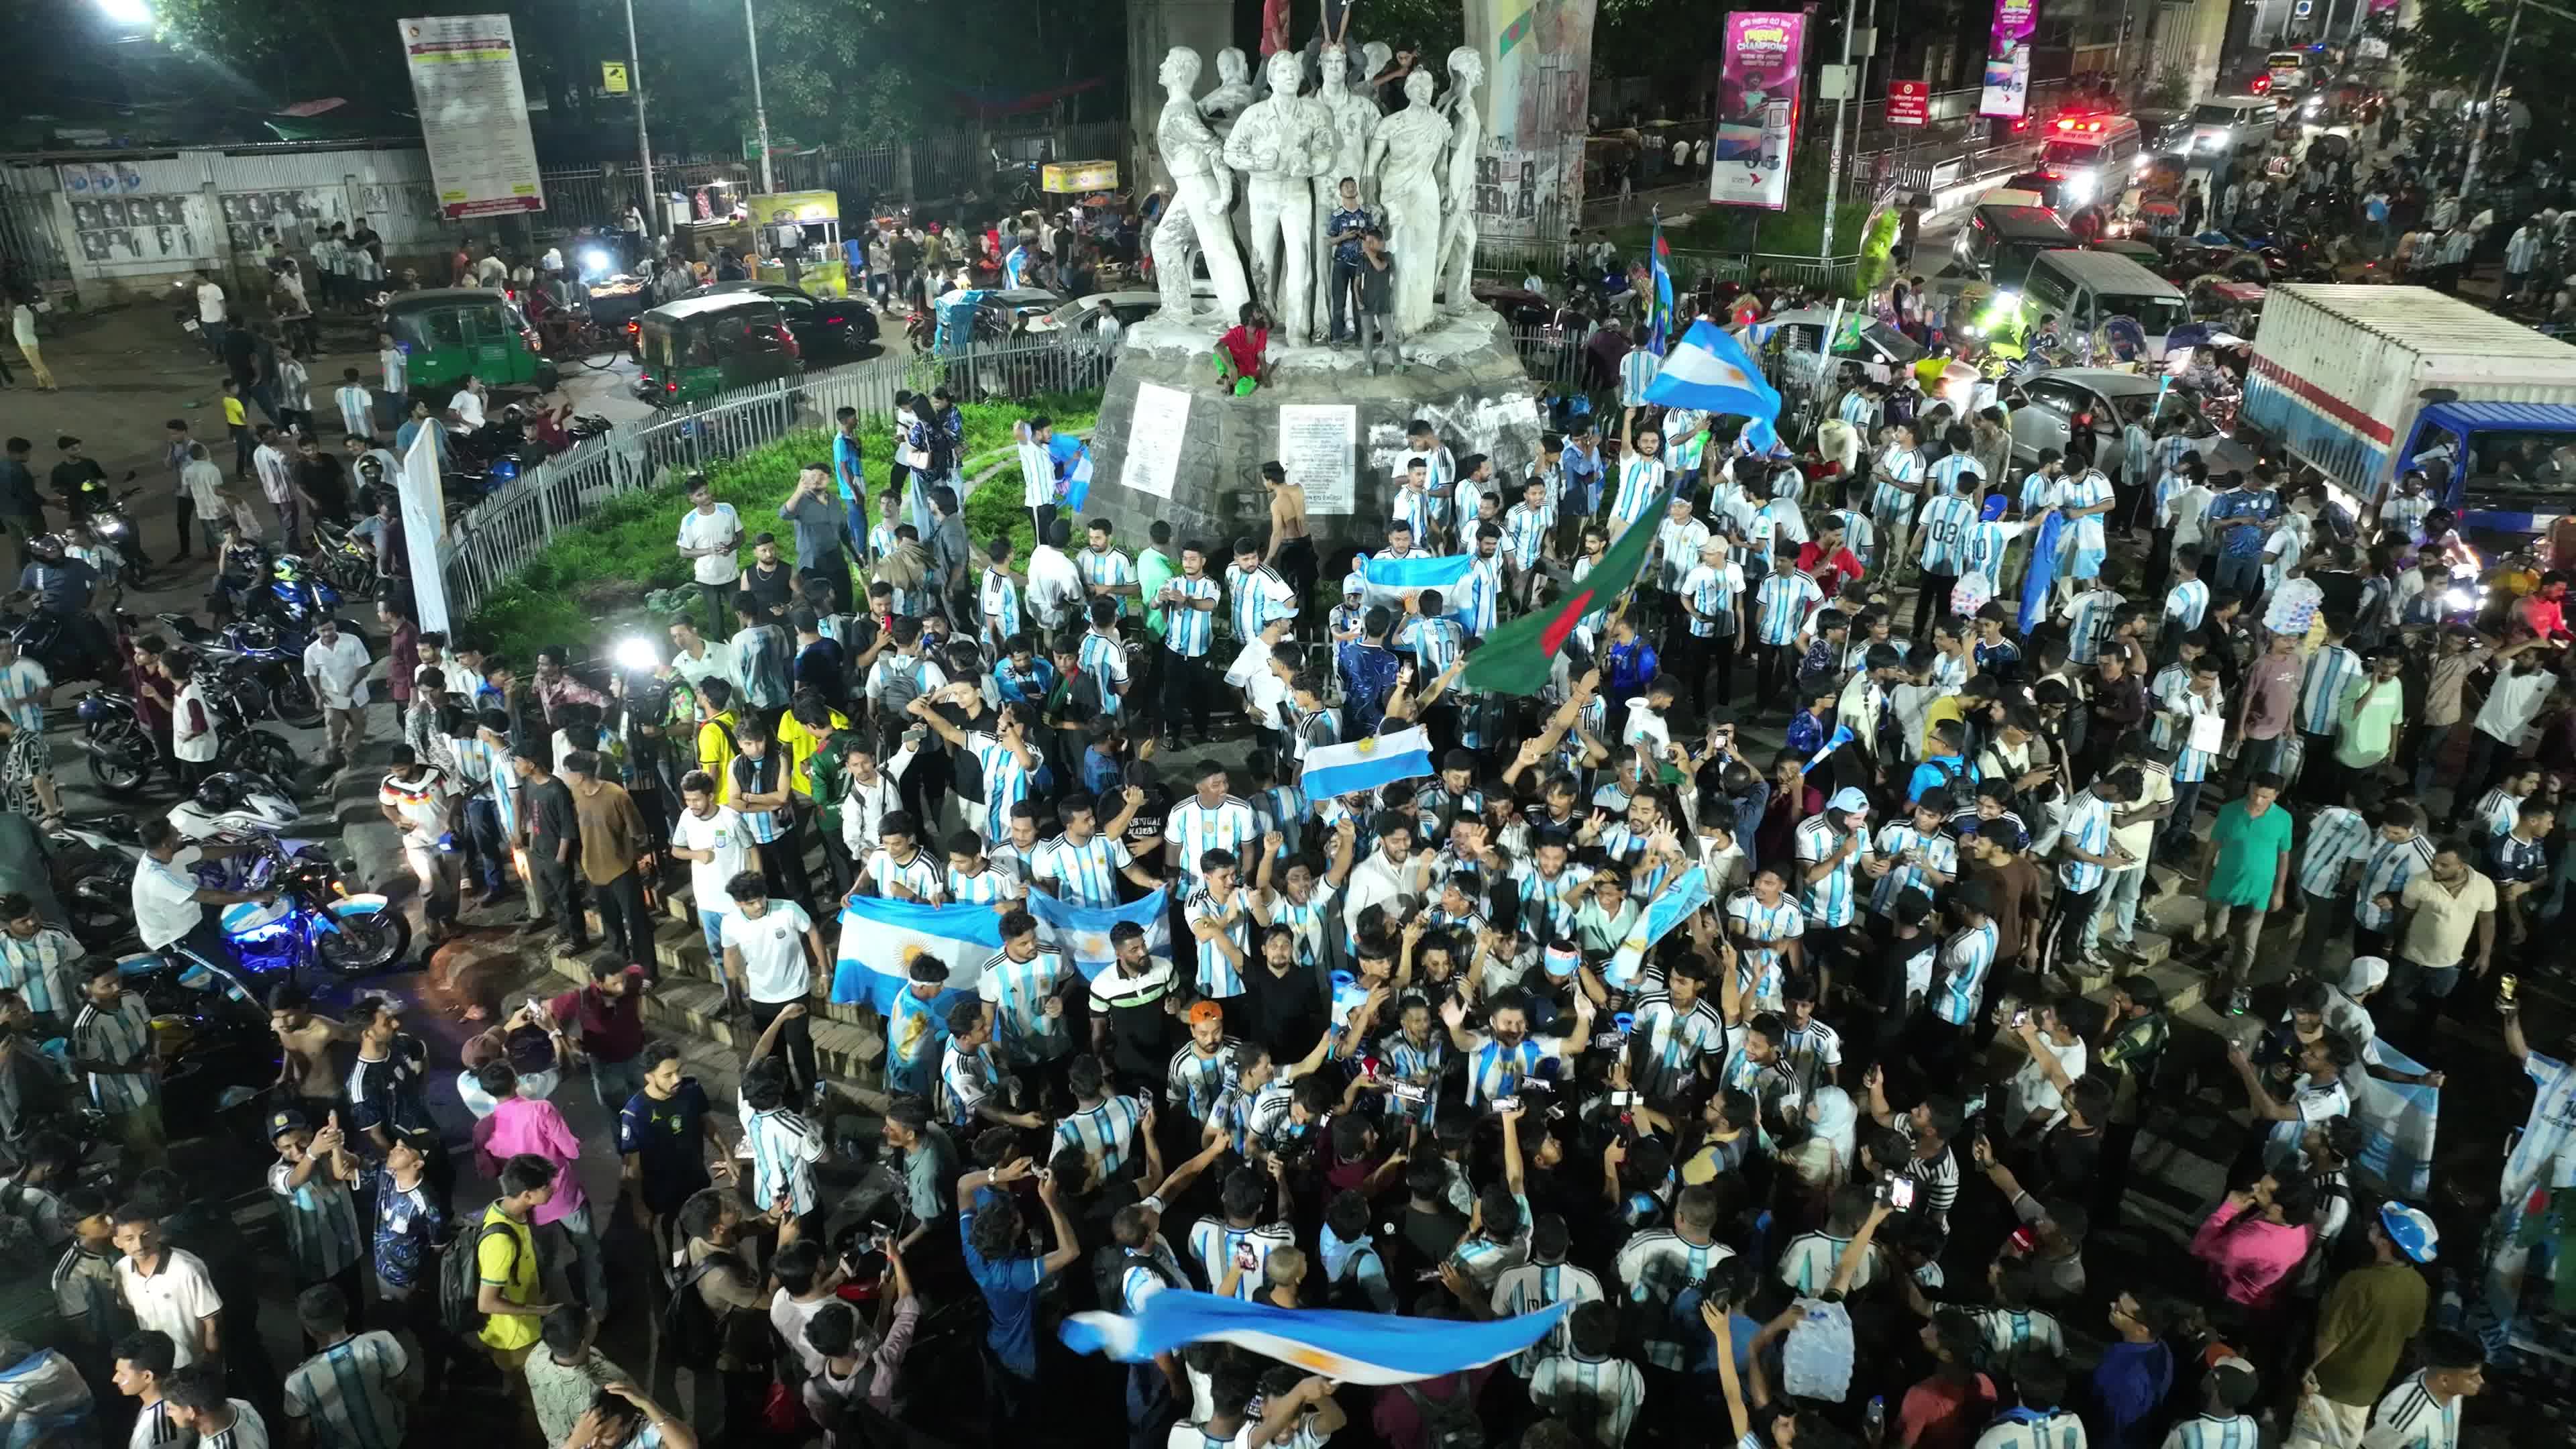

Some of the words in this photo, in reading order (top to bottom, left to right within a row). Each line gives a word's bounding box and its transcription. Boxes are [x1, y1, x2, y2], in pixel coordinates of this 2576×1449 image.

[1736, 42, 1788, 53] CHAMPIONS
[2089, 619, 2115, 641] 10
[1435, 639, 1455, 665] 10
